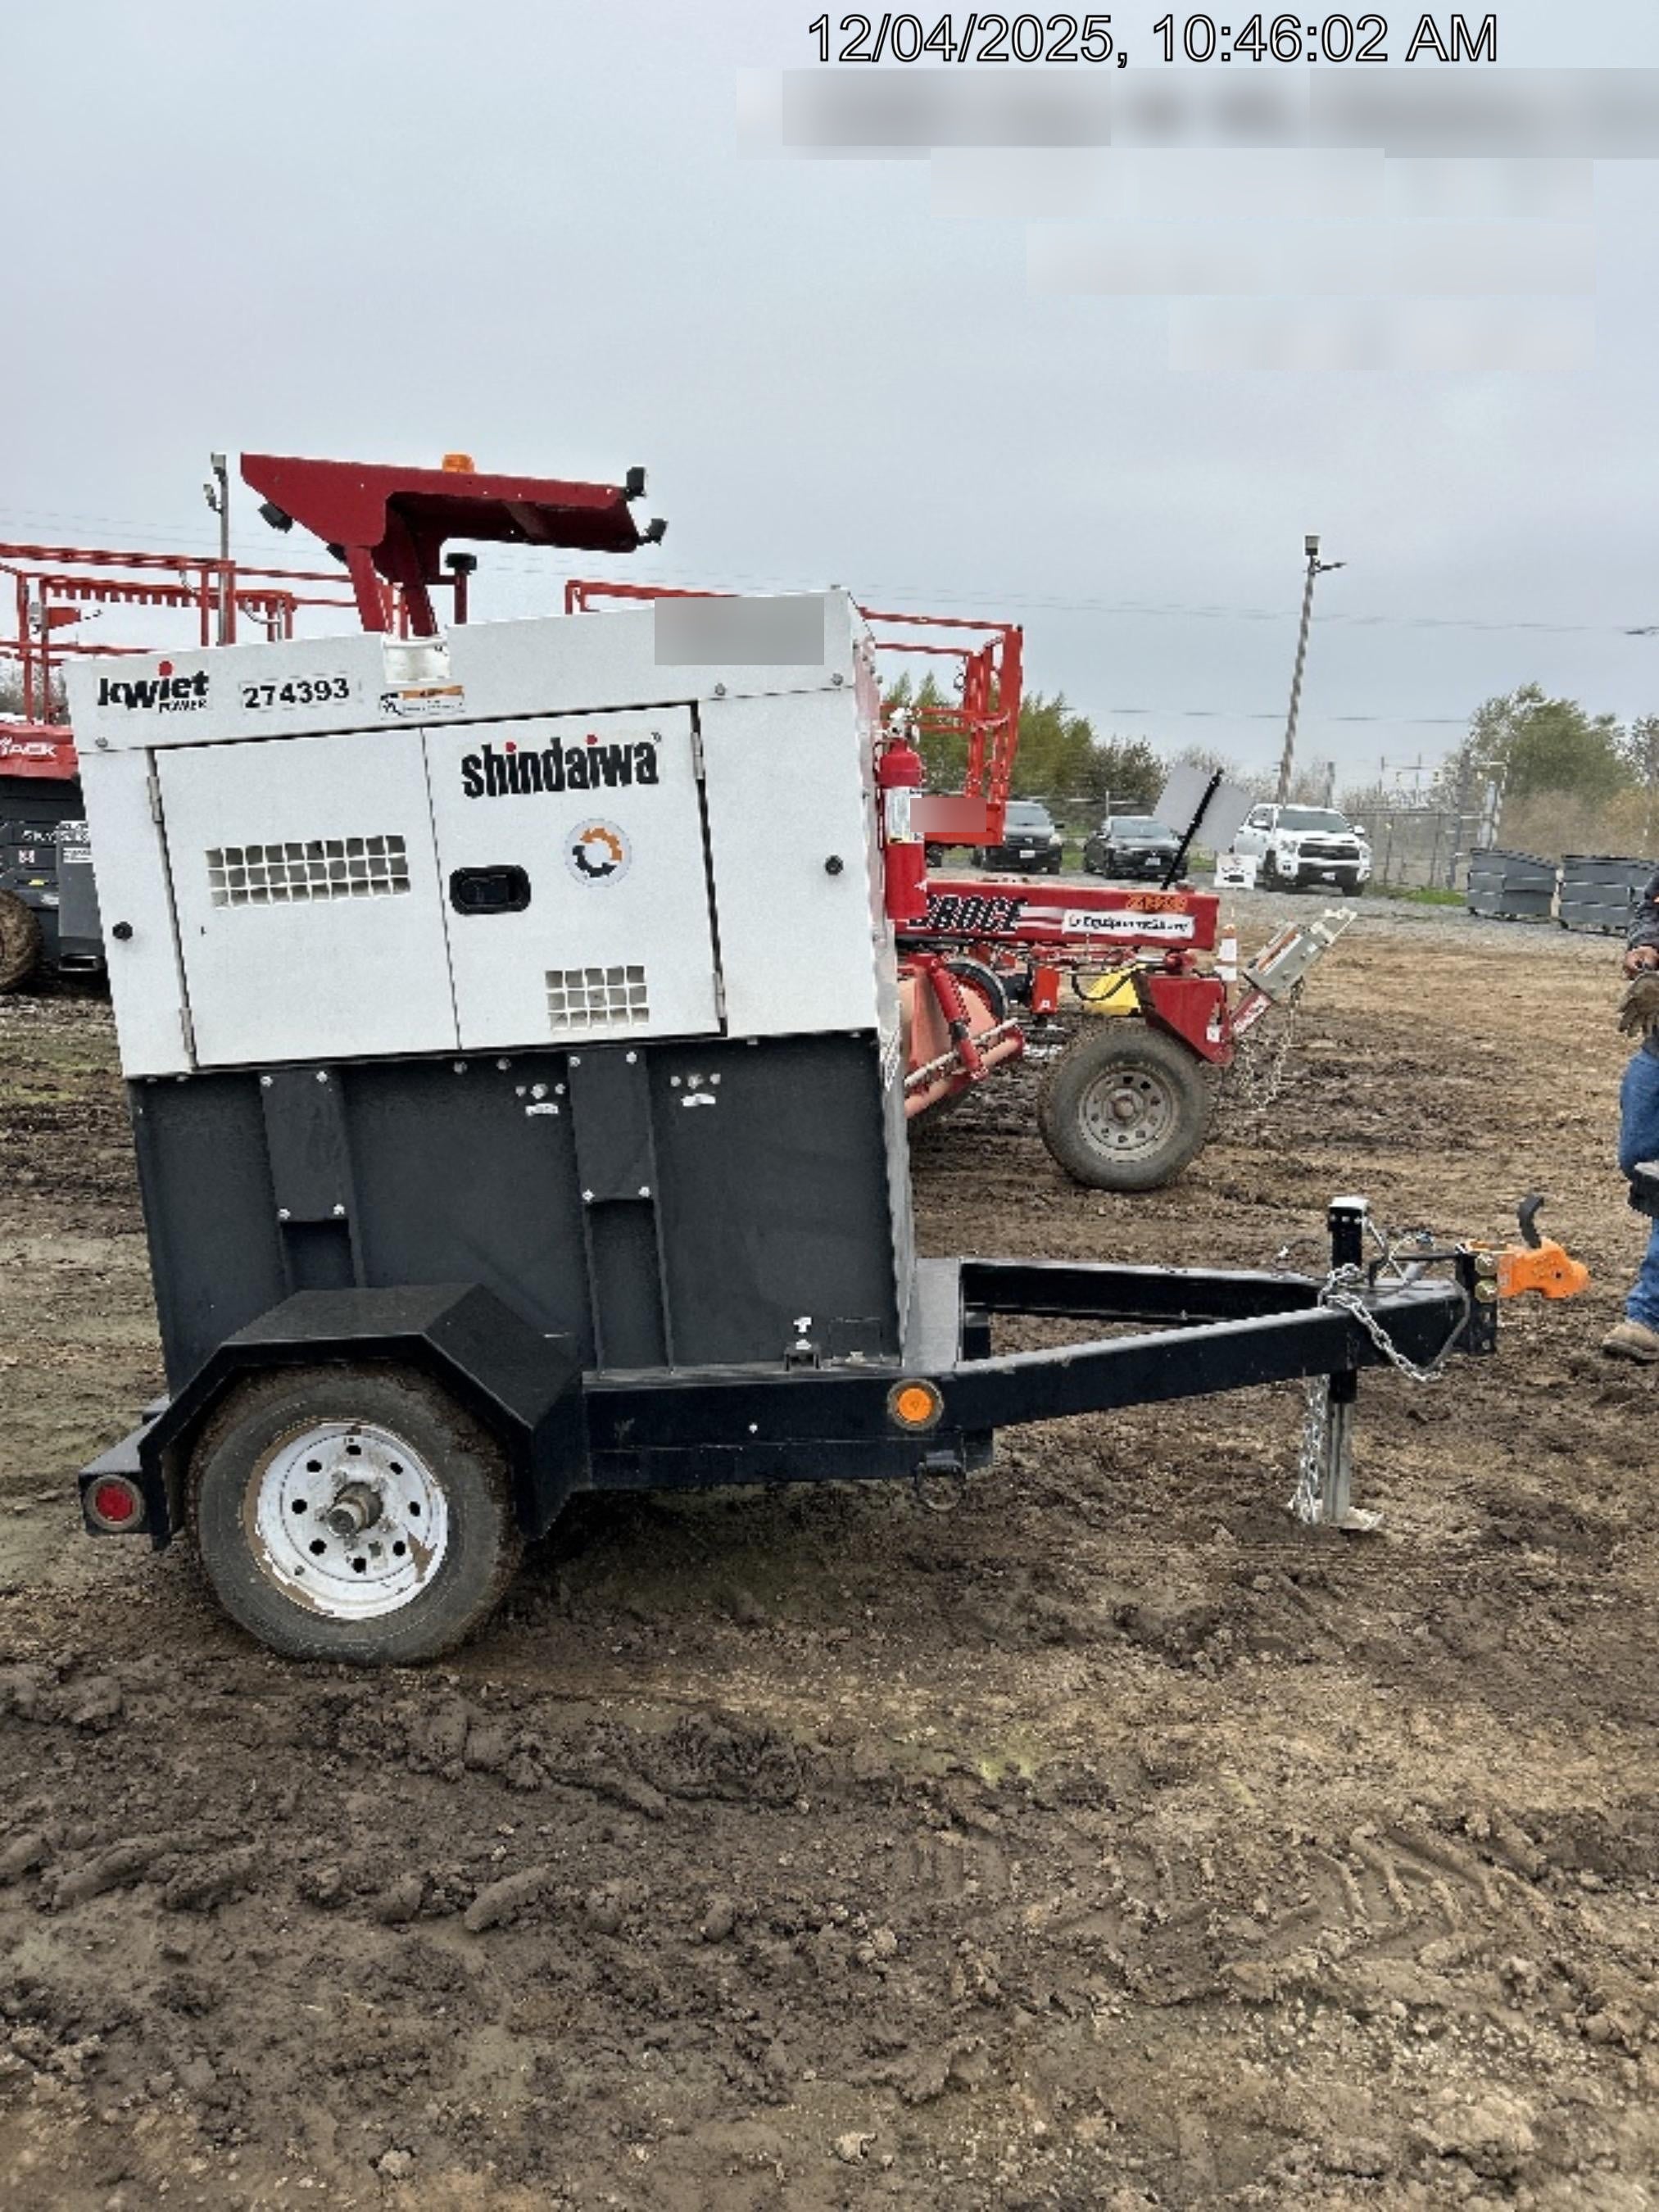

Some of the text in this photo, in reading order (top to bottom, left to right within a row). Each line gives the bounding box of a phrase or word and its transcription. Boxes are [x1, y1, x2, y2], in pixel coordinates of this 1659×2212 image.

[97, 660, 210, 710] kwiet
[243, 678, 350, 708] 274393
[461, 734, 660, 799] shindaiwa
